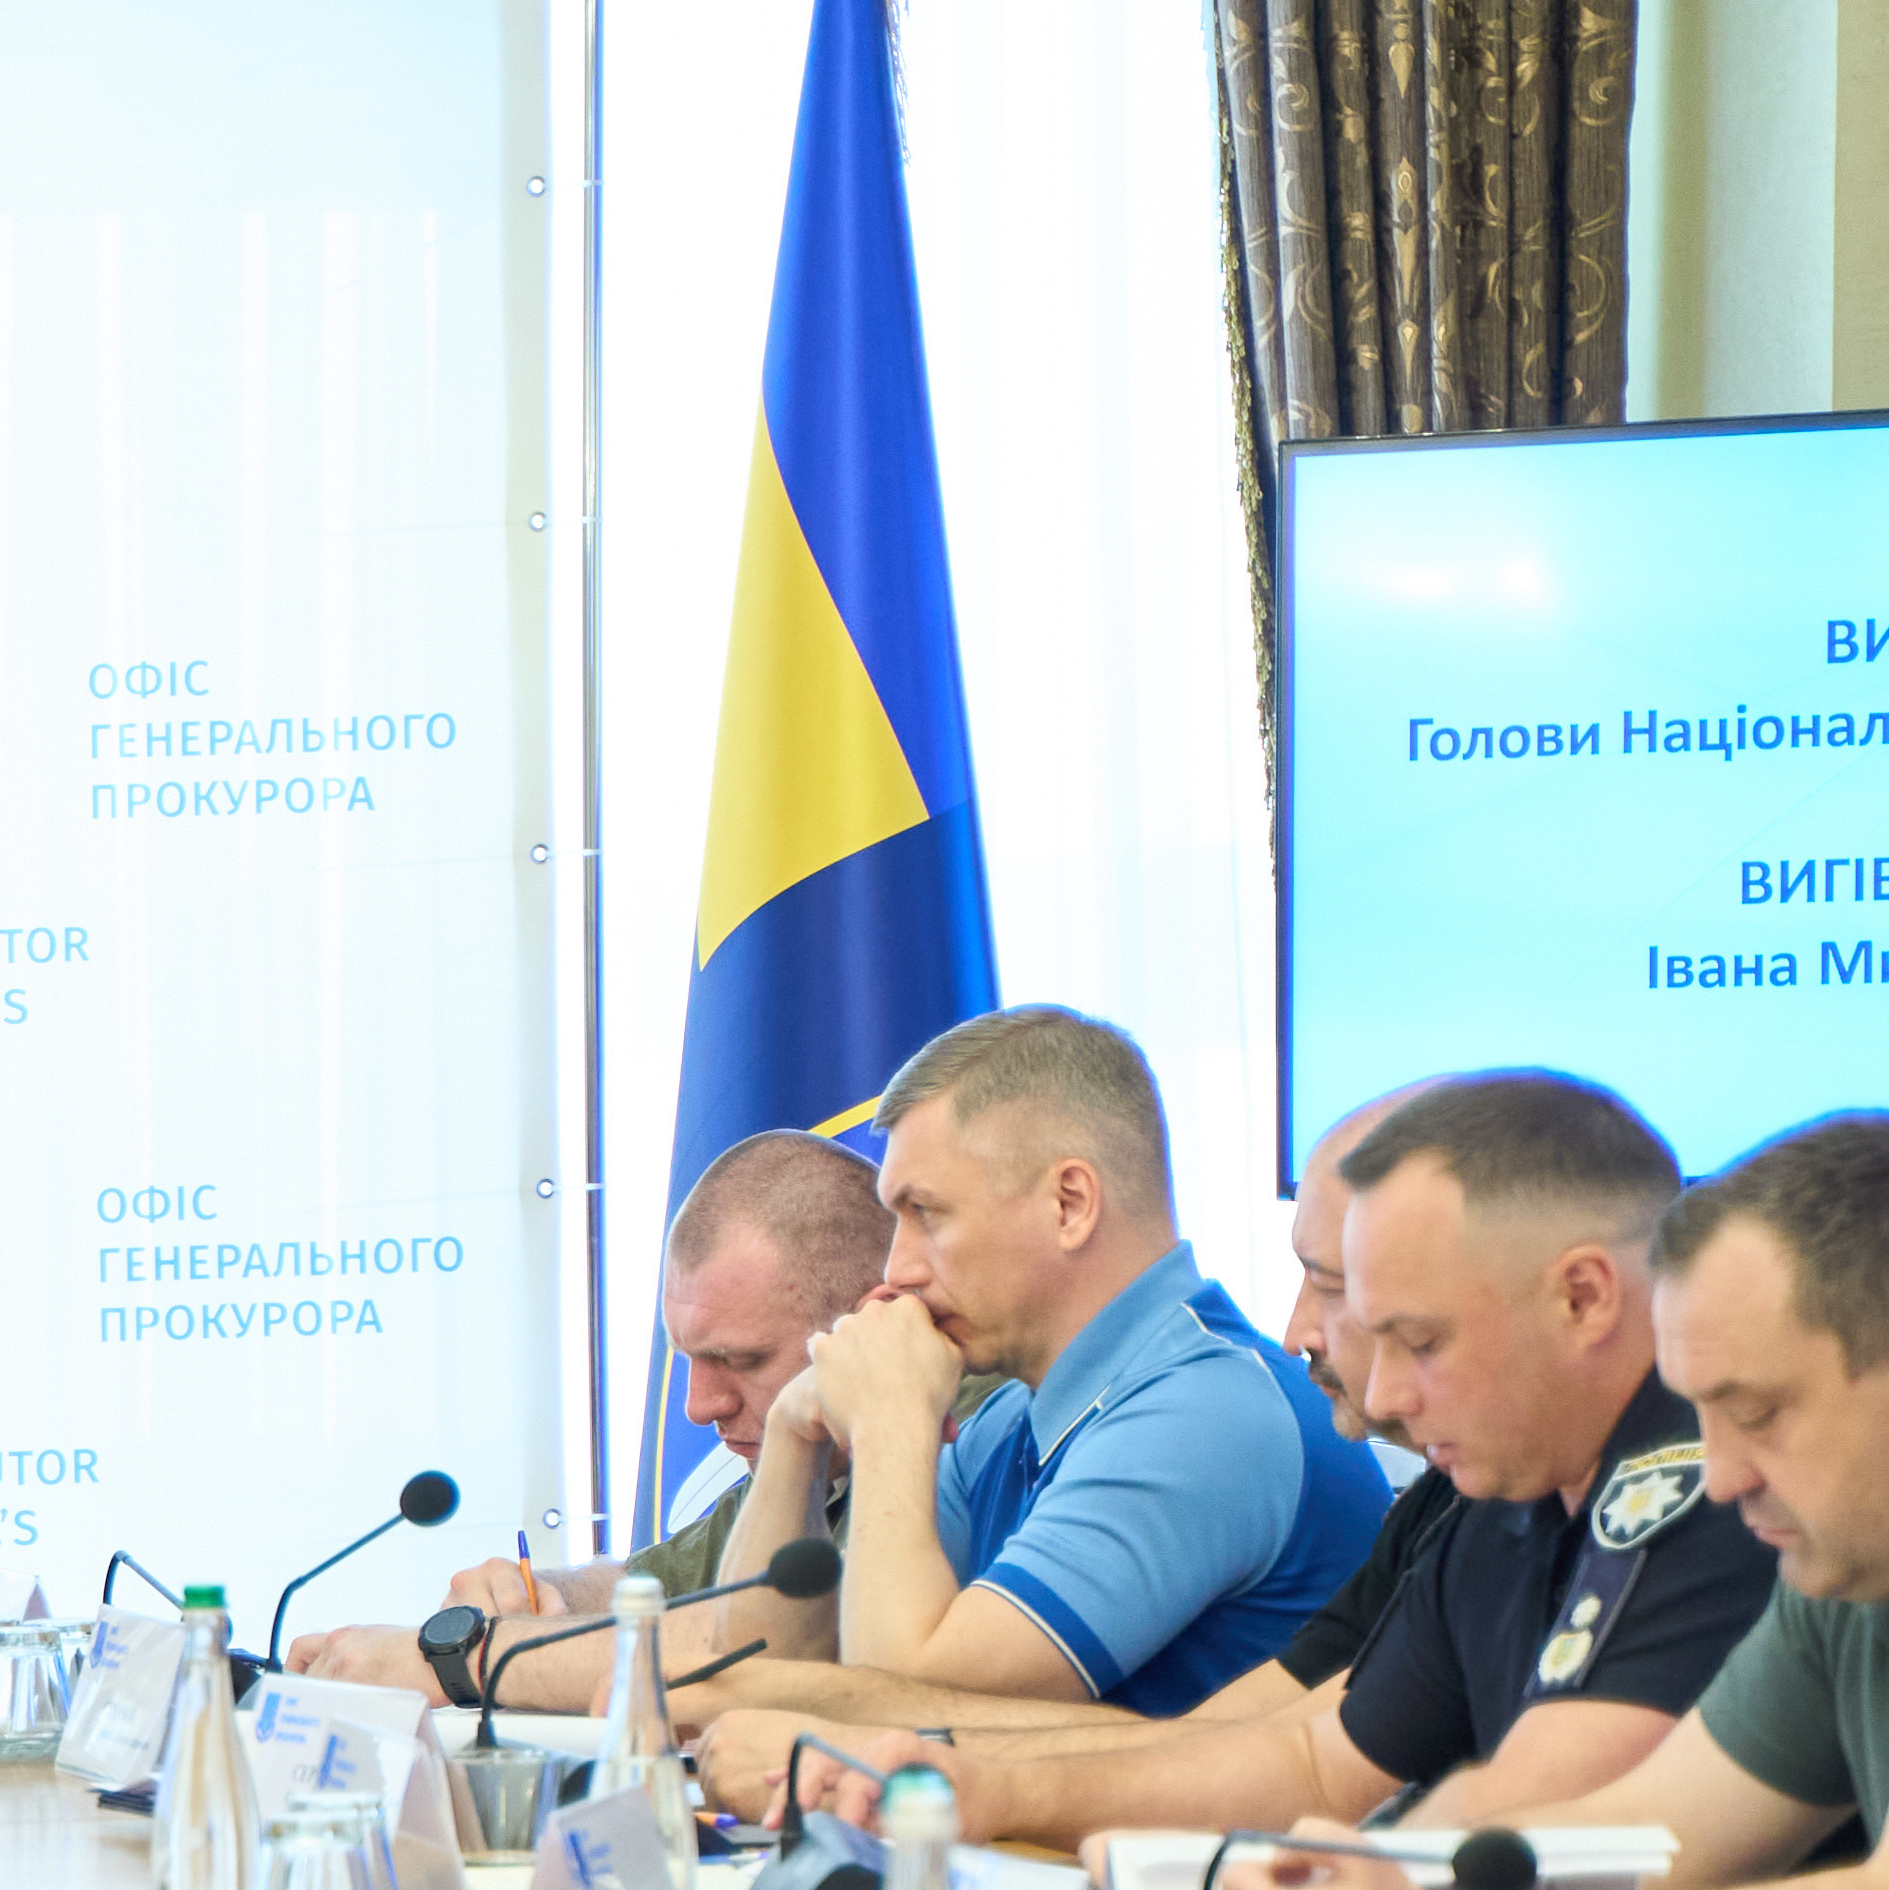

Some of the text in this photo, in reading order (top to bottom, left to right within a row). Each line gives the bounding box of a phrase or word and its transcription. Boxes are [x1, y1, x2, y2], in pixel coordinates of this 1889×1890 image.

[87, 659, 210, 700] ОФІС
[90, 711, 458, 760] ГЕНЕРАЛЬНОГО
[1408, 702, 1889, 764] Голови Націонал
[91, 775, 376, 820] ПРОКУРОРА
[1647, 940, 1889, 990] Івана М
[96, 1183, 218, 1225] ОФІС
[98, 1234, 465, 1284] ГЕНЕРАЛЬНОГО
[99, 1297, 384, 1343] ПРОКУРОРА
